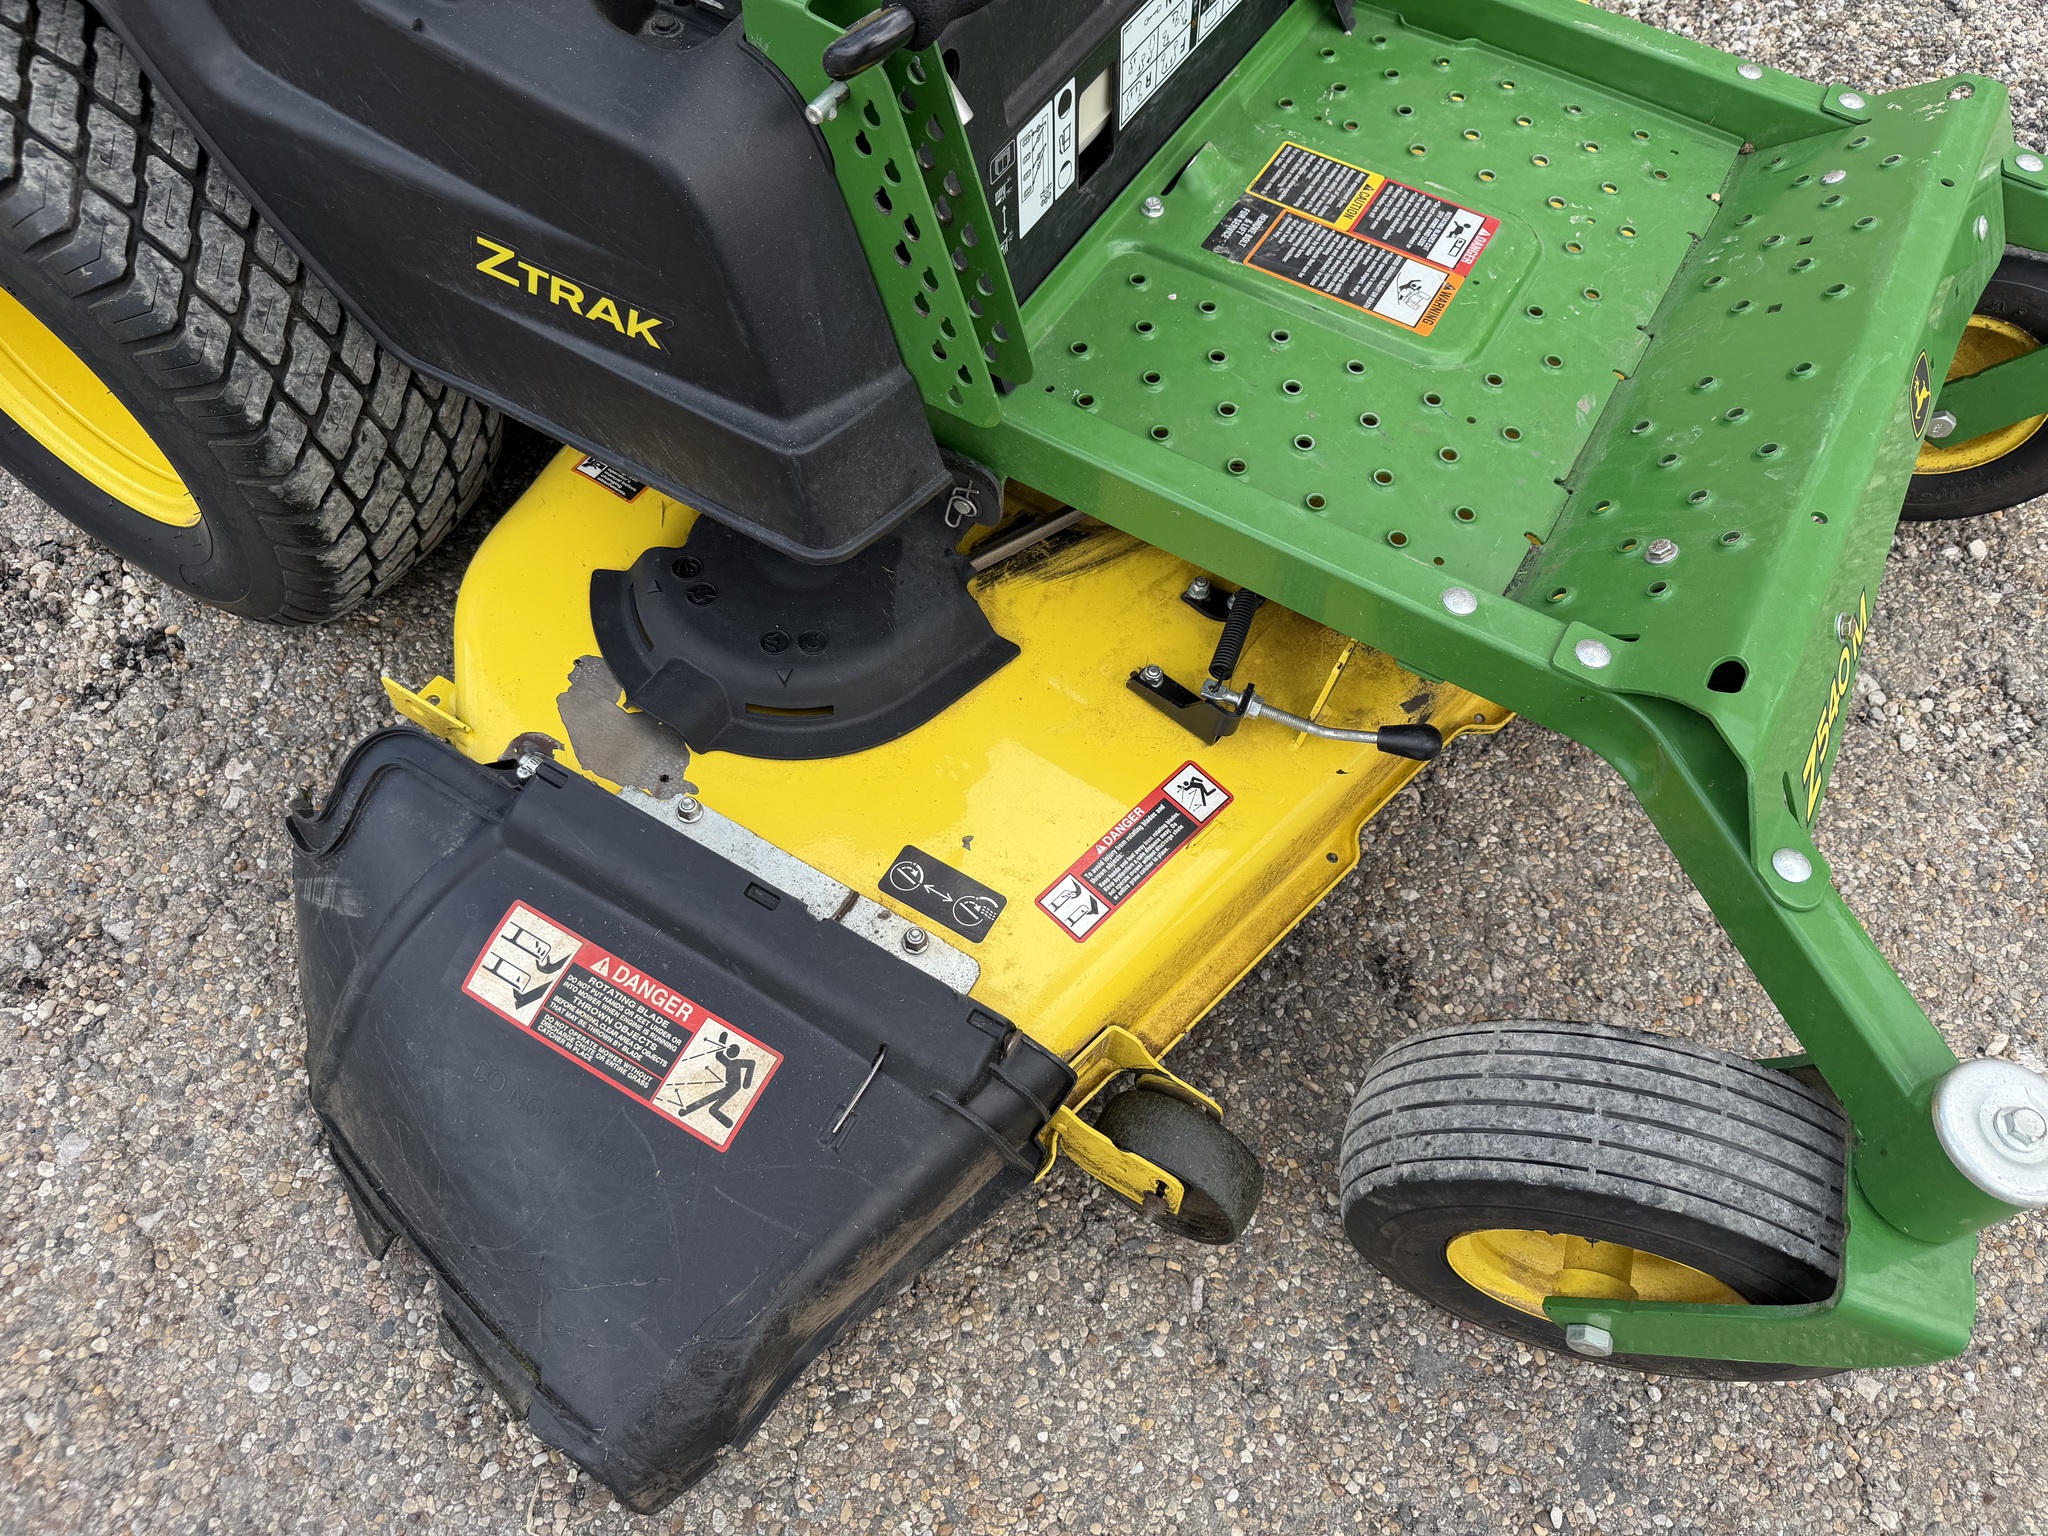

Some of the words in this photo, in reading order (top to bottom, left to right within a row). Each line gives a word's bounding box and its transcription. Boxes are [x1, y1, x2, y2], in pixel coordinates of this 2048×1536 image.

[1220, 217, 1242, 239] SERVICE
[1234, 222, 1249, 235] LIFT
[1236, 207, 1250, 219] FOR
[1246, 213, 1268, 235] REMOVE
[1342, 190, 1370, 220] CAUTION
[1236, 233, 1253, 247] BOLT
[1460, 235, 1487, 265] DANGER
[1421, 290, 1451, 325] WARNING
[600, 474, 623, 489] changing
[603, 471, 622, 482] manual
[622, 481, 637, 492] before
[1802, 588, 1868, 824] Z540M
[1083, 870, 1093, 879] To
[1089, 859, 1105, 874] avoid
[1114, 838, 1128, 851] from
[1124, 823, 1144, 842] rotating
[1140, 810, 1158, 827] blades
[1154, 803, 1166, 814] and
[1101, 806, 1145, 846] DANGER
[1089, 867, 1107, 884] thrown
[1104, 851, 1126, 871] objects:
[1097, 876, 1110, 888] Keep
[1107, 865, 1121, 878] hands
[1118, 858, 1128, 868] and
[1125, 851, 1136, 861] feet
[1133, 843, 1146, 855] away
[1142, 835, 1154, 845] from
[1151, 822, 1168, 838] rotating
[1102, 880, 1115, 892] Keep
[1112, 861, 1135, 883] bystanders
[1135, 851, 1146, 861] safe
[1143, 836, 1161, 853] distance
[1169, 821, 1178, 829] Do
[1107, 887, 1116, 896] not
[1113, 874, 1131, 890] operate
[1128, 862, 1143, 876] mower
[1141, 849, 1157, 864] without
[1154, 833, 1175, 852] discharge
[1171, 823, 1184, 835] chute
[1116, 882, 1130, 896] entire
[1128, 873, 1141, 885] grass
[1138, 860, 1154, 875] catcher
[562, 979, 578, 993] INTO
[576, 988, 601, 1007] MOWER
[600, 1002, 620, 1018] WHEN
[618, 1013, 643, 1031] ENGINE
[641, 1027, 650, 1036] IS
[648, 1031, 678, 1052] RUNNING
[566, 973, 578, 984] DO
[576, 979, 591, 991] NOT
[589, 987, 603, 999] PUT
[601, 994, 625, 1012] HANDS
[623, 1007, 635, 1018] OR
[633, 1013, 650, 1027] FEET
[648, 1023, 671, 1040] UNDER
[670, 1035, 682, 1046] OR
[588, 975, 636, 1009] ROTATING
[636, 1004, 670, 1029] BLADE
[611, 963, 695, 1023] DANGER
[536, 1023, 566, 1045] CATCHER
[564, 1041, 573, 1049] IN
[571, 1045, 593, 1062] PLACE
[543, 1013, 555, 1024] DO
[553, 1019, 569, 1032] NOT
[567, 1027, 598, 1050] OPERATE
[597, 1046, 623, 1065] MOWER
[622, 1061, 653, 1083] WITHOUT
[549, 1001, 565, 1014] THAT
[564, 1010, 578, 1022] MAY
[577, 1018, 587, 1028] BE
[586, 1023, 613, 1043] THROWN
[611, 1039, 622, 1048] BY
[620, 1044, 643, 1061] BLADE
[552, 994, 576, 1012] BEFORE
[574, 1007, 600, 1027] MOWING,
[598, 1022, 618, 1037] CLEAR
[617, 1033, 634, 1047] AREA
[632, 1042, 643, 1052] OF
[640, 1047, 668, 1068] OBJECTS
[571, 995, 613, 1024] THROWN
[612, 1020, 658, 1052] OBJECTS
[540, 1018, 576, 1044] DISCHARGE
[574, 1039, 596, 1056] CHUTE
[594, 1051, 606, 1062] OR
[604, 1057, 627, 1075] ENTIRE
[626, 1071, 650, 1089] GRASS
[473, 1059, 507, 1092] DO
[507, 1084, 562, 1127] NOT
